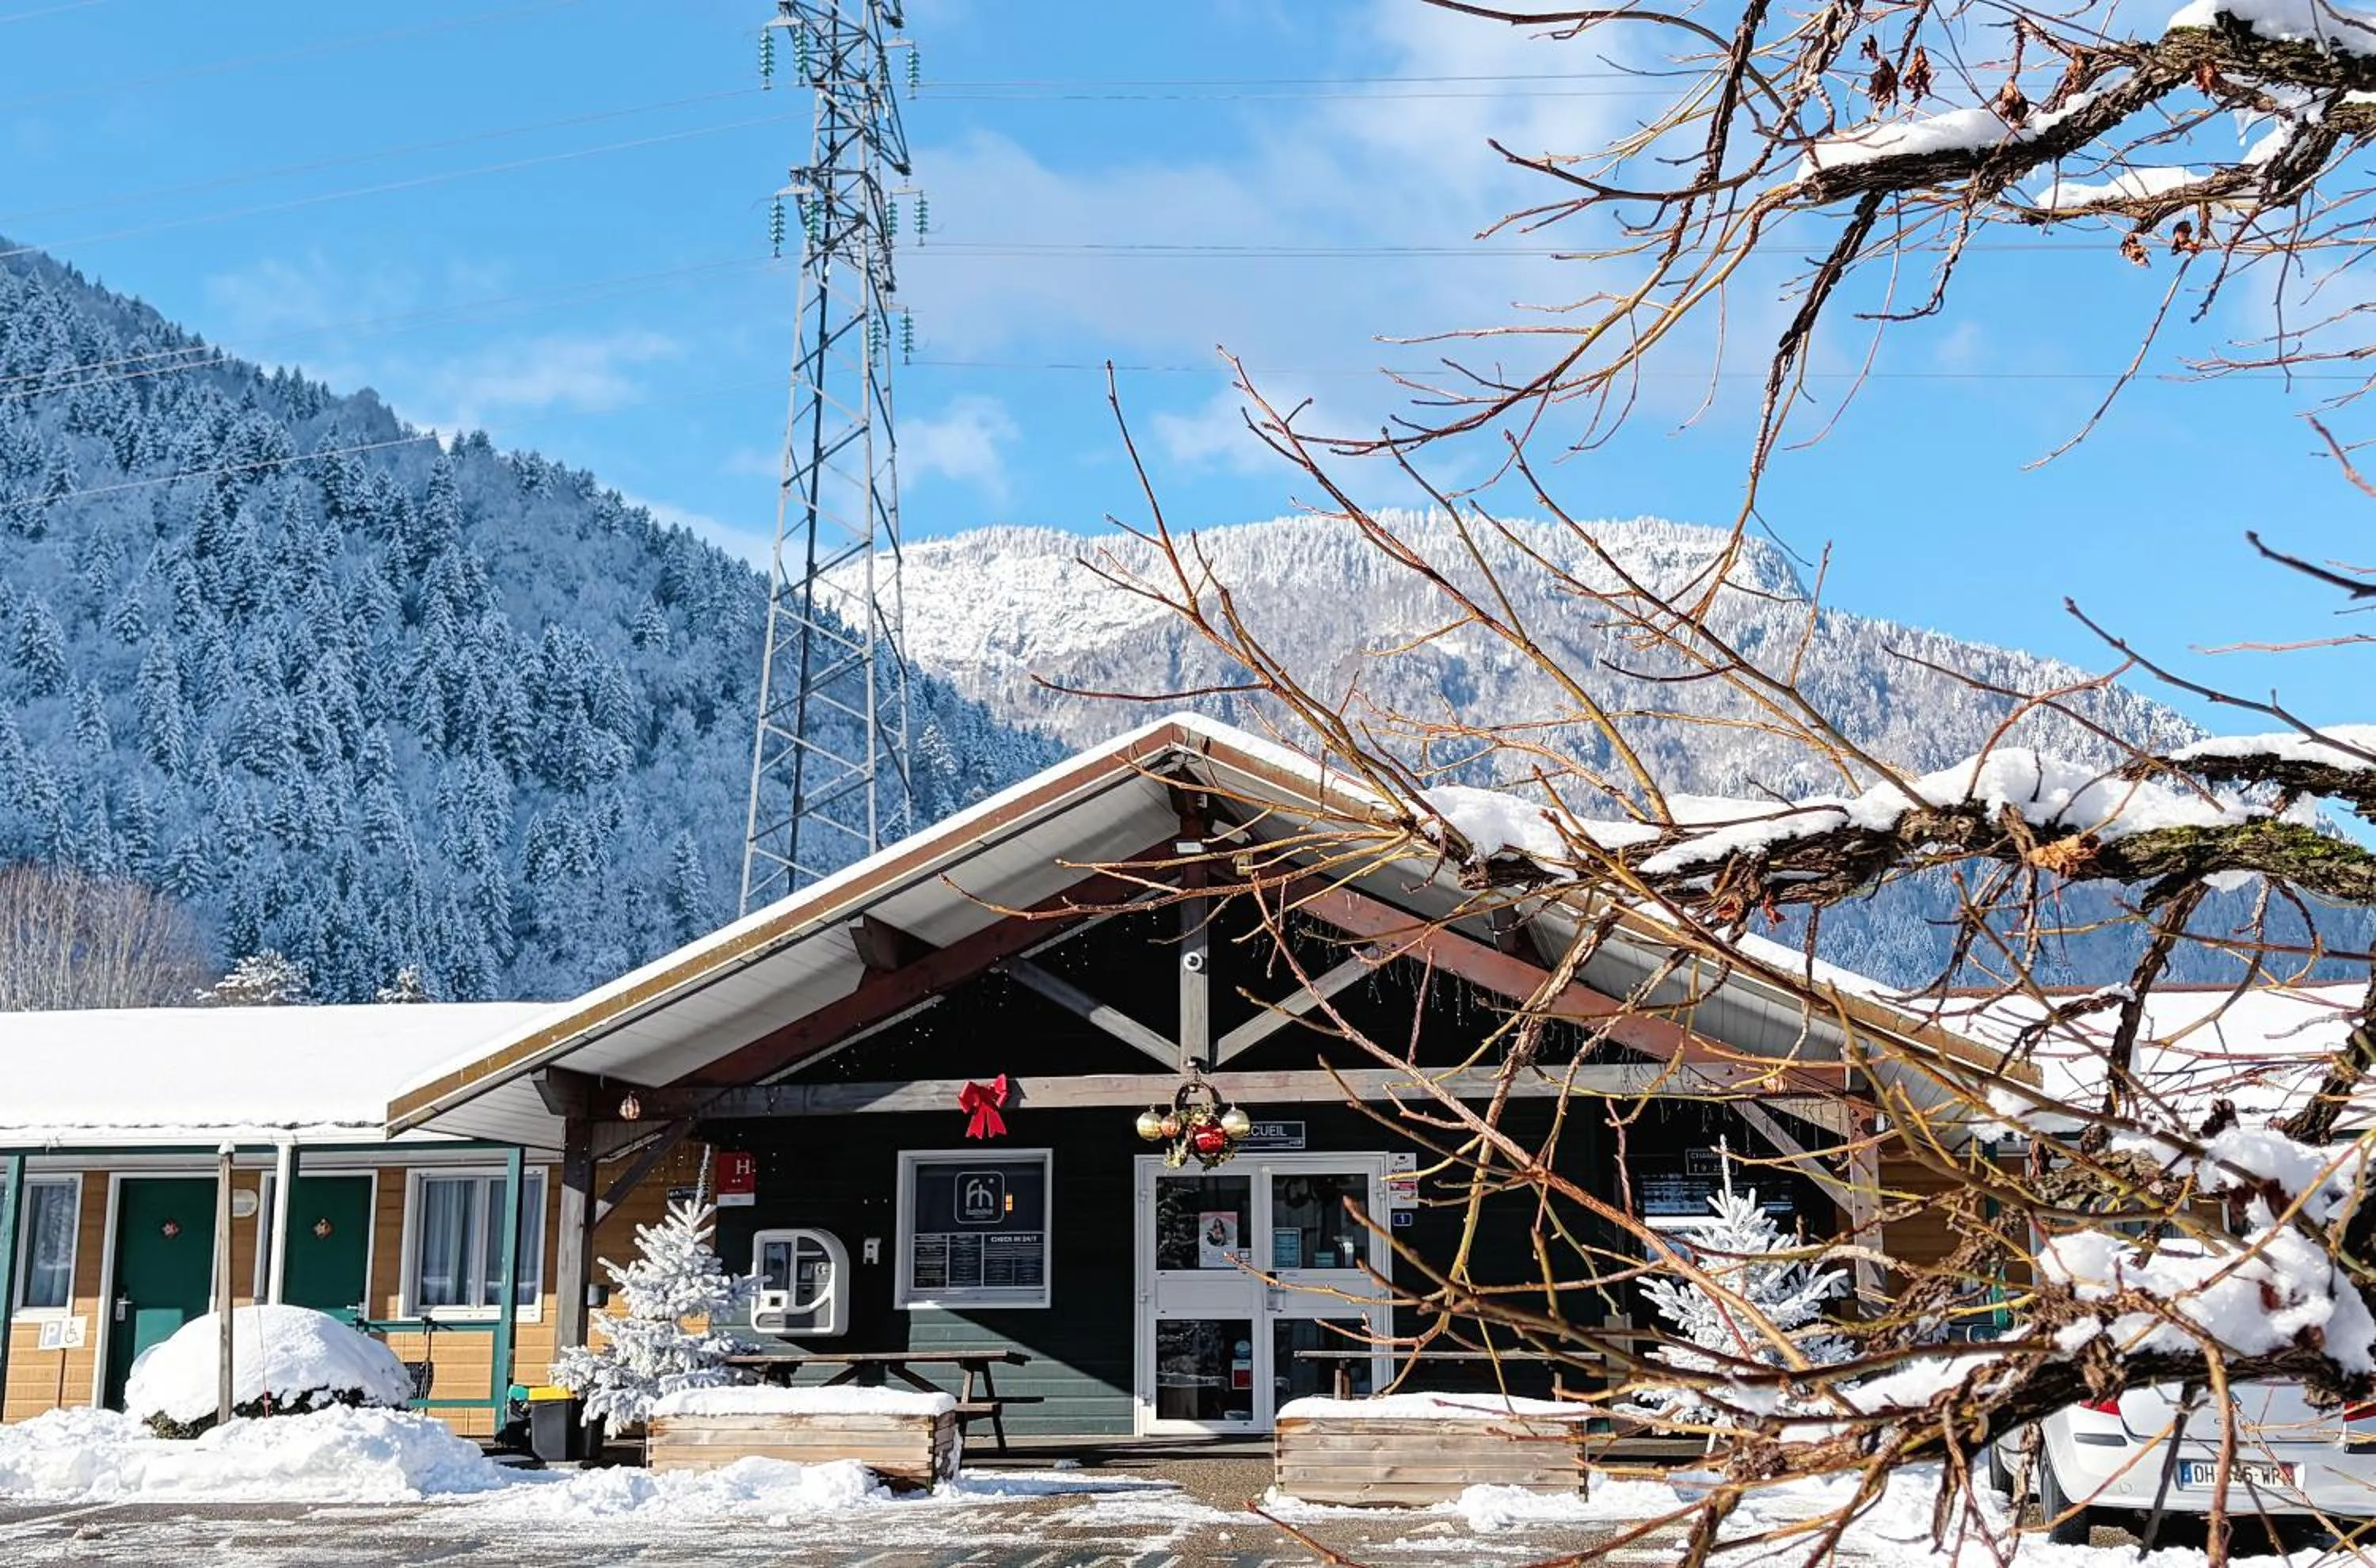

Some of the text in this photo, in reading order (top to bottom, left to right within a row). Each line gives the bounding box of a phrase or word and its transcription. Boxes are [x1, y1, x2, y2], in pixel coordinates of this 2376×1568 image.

[1244, 1125, 1287, 1136] CUEIL
[736, 1159, 750, 1174] H
[44, 1323, 58, 1345] P
